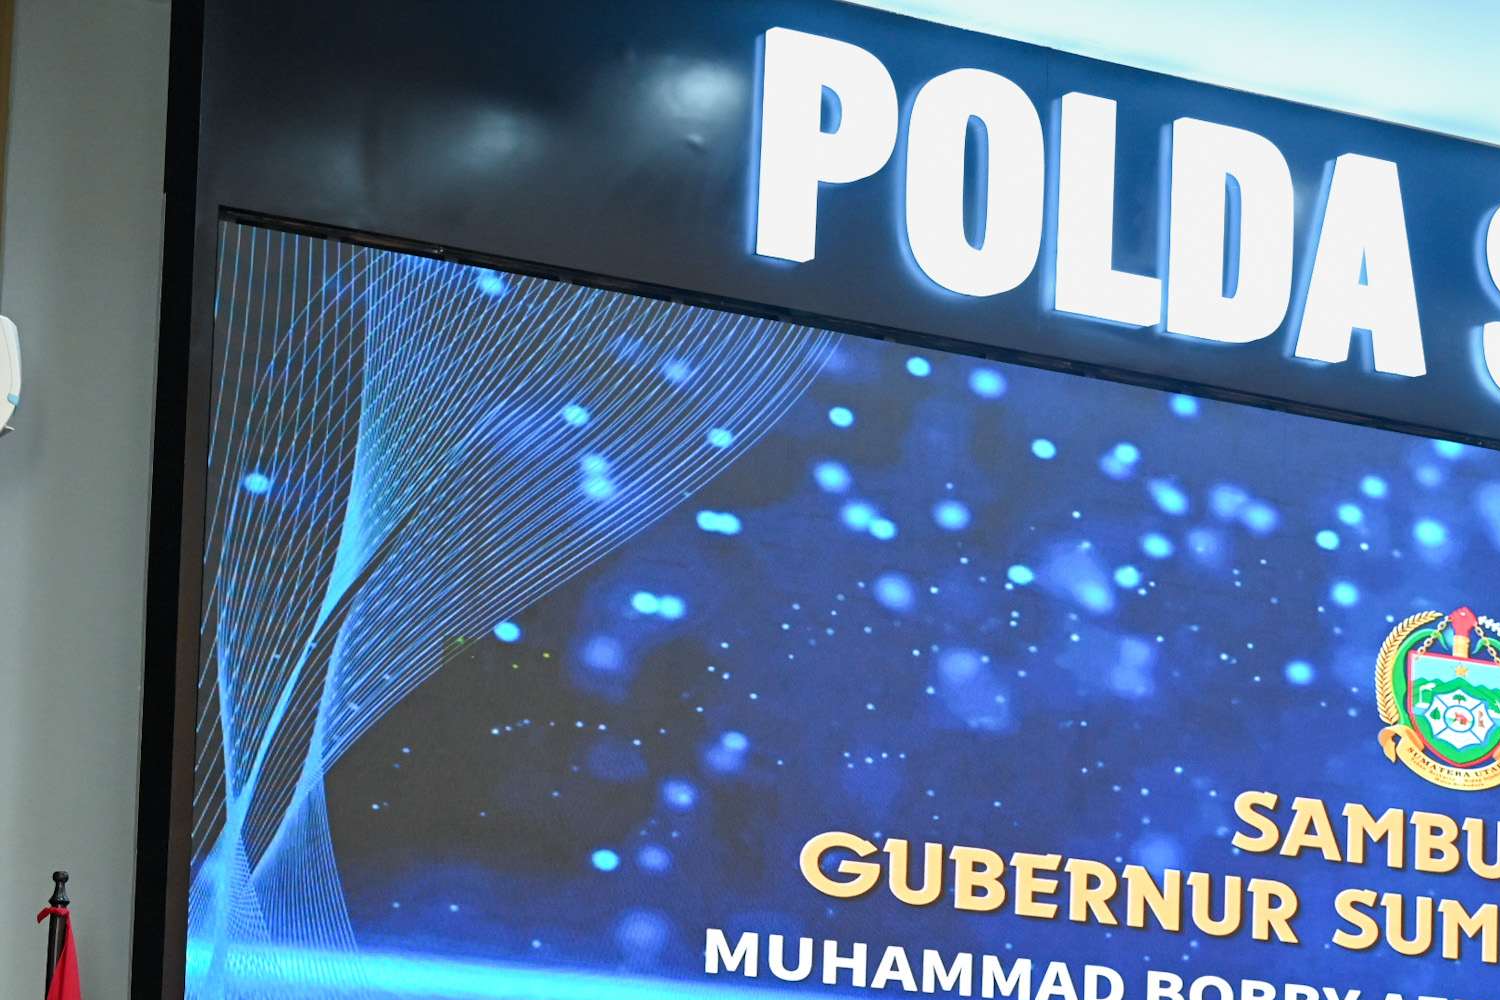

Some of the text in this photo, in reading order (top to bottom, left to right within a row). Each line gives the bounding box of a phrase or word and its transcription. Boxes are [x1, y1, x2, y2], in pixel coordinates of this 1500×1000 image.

[753, 26, 1427, 378] POLDA
[1407, 747, 1470, 778] SUMATERA
[799, 830, 1300, 945] GUBERNUR
